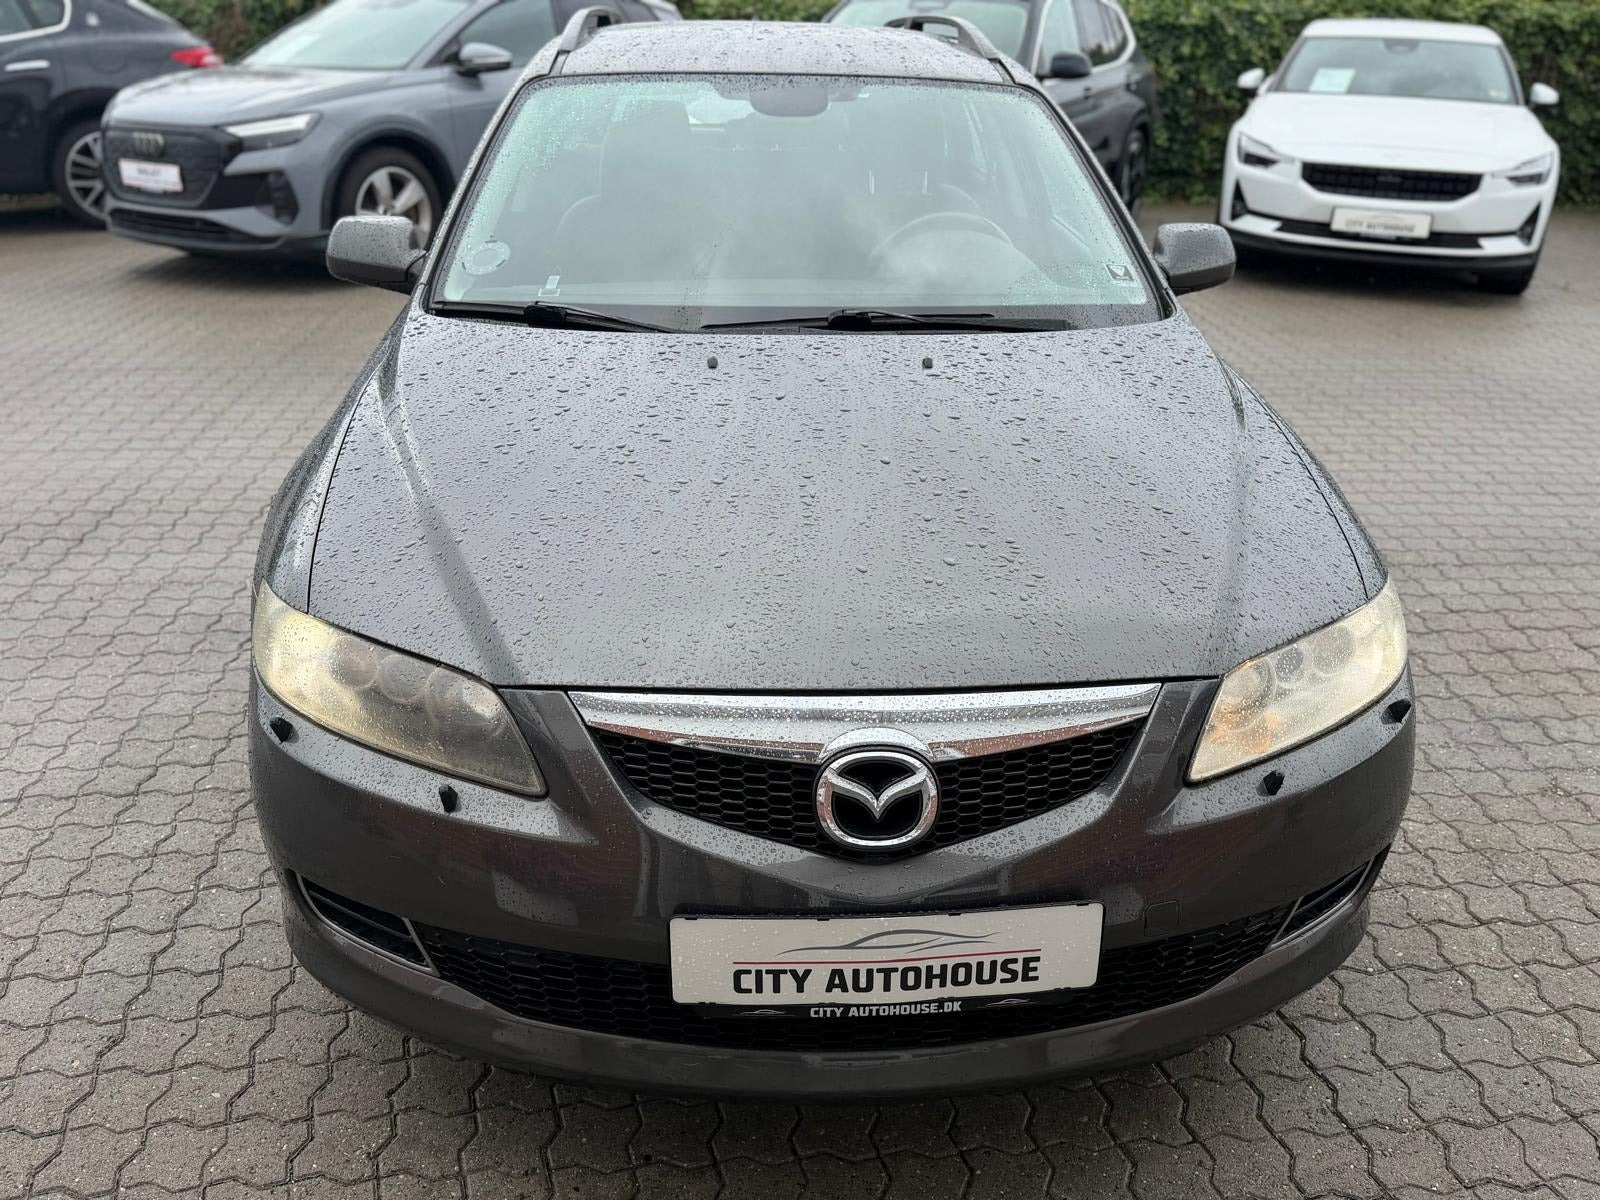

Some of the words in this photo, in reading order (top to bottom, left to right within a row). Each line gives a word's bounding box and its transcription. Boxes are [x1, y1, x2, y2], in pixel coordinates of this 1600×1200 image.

[733, 969, 812, 994] CITY
[825, 956, 1041, 993] AUTOHOUSE
[810, 1007, 844, 1018] CITY
[848, 1001, 962, 1017] AUTOHOUSE.DK
